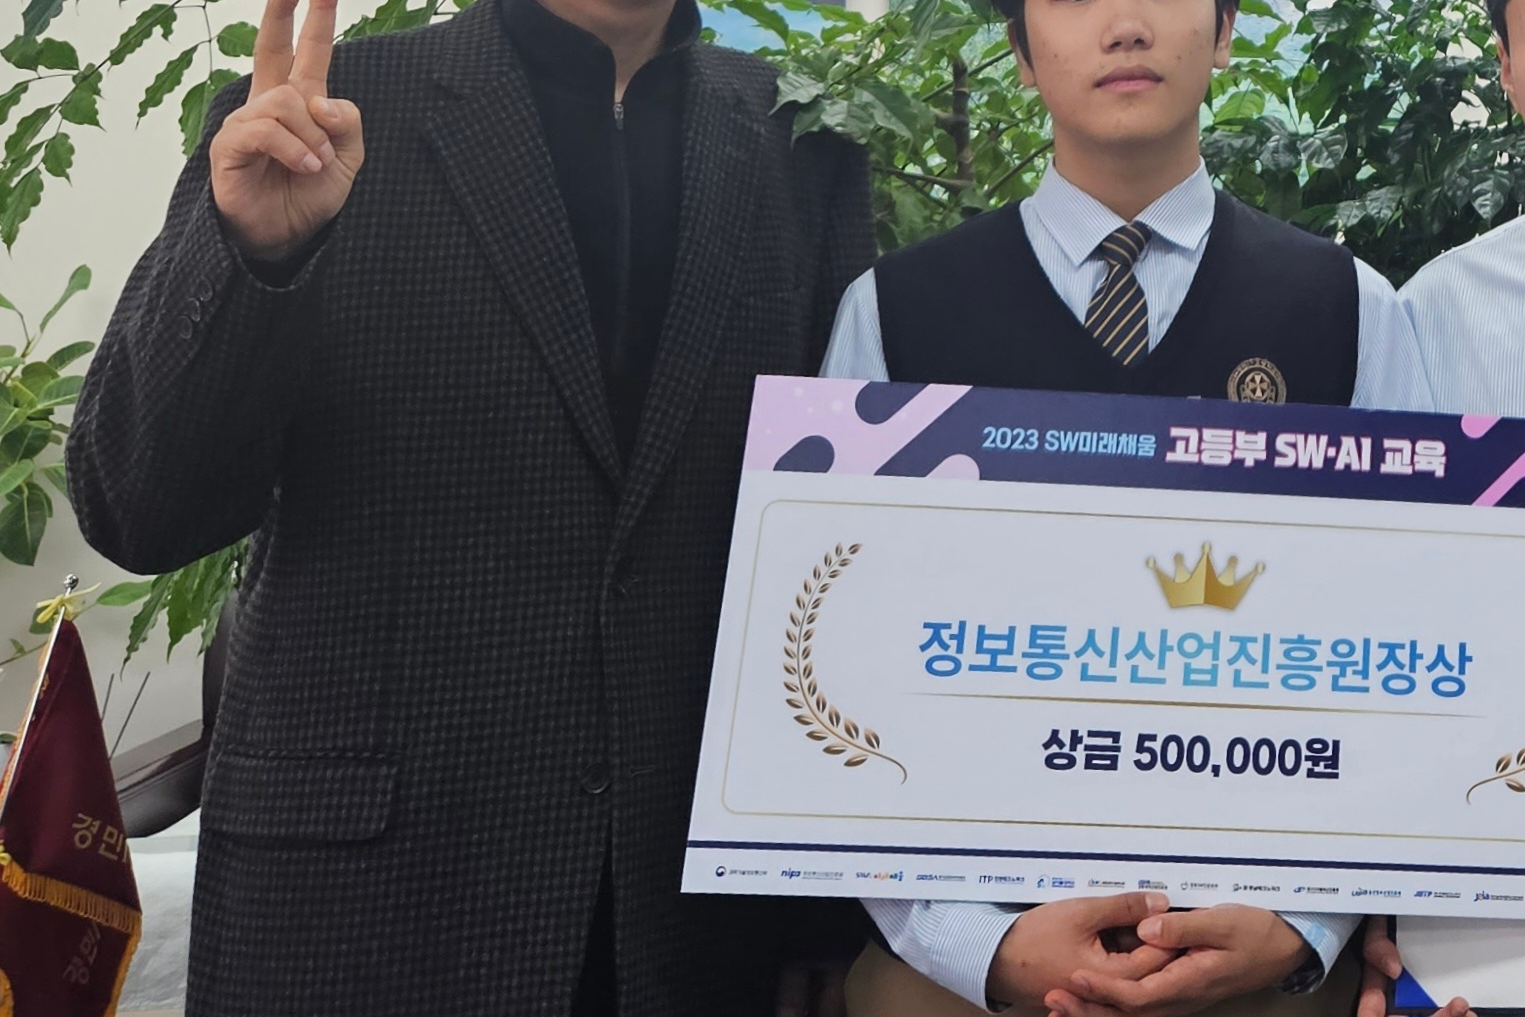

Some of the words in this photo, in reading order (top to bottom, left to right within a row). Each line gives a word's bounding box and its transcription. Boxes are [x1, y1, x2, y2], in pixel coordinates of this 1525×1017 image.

[982, 426, 1039, 450] 2023
[1044, 430, 1157, 457] SW미래채움
[1165, 426, 1268, 468] 고등부
[1379, 437, 1447, 478] 교육
[919, 620, 1473, 698] 정보통신산업진흥원장상
[1041, 728, 1122, 771] 상금
[1133, 734, 1341, 780] 500,000원
[72, 813, 128, 863] 경민
[979, 875, 994, 884] ITP
